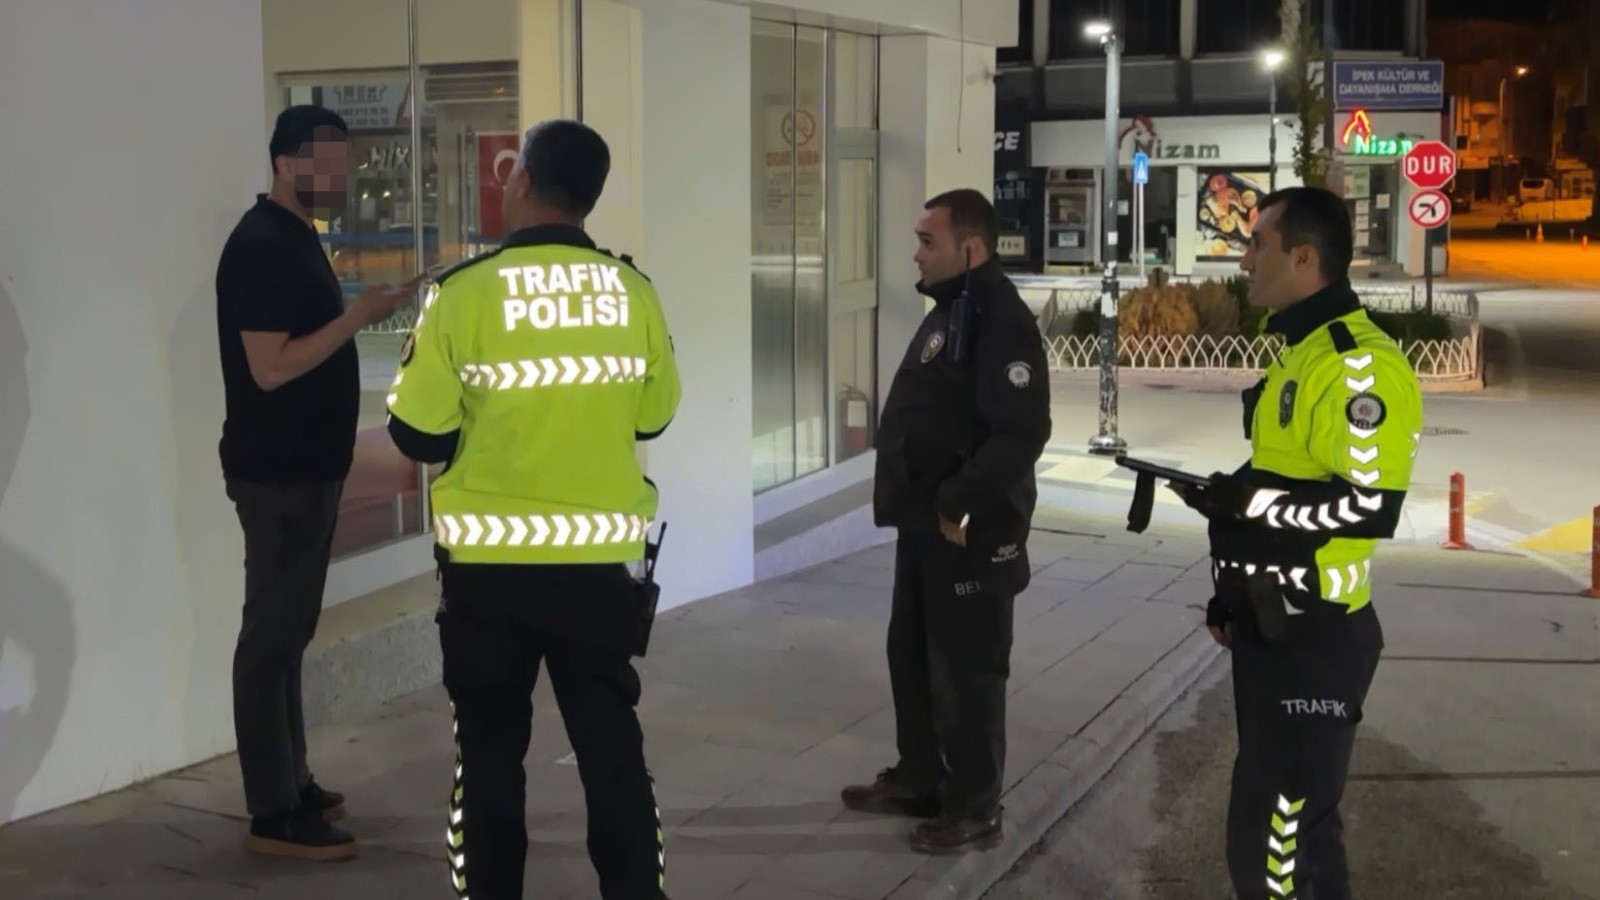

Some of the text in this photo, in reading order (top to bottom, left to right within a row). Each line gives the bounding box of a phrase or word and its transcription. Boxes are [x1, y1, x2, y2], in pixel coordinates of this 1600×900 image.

[1377, 67, 1416, 81] KÜLTÜR
[1417, 69, 1430, 81] VE
[1407, 155, 1452, 176] DUR
